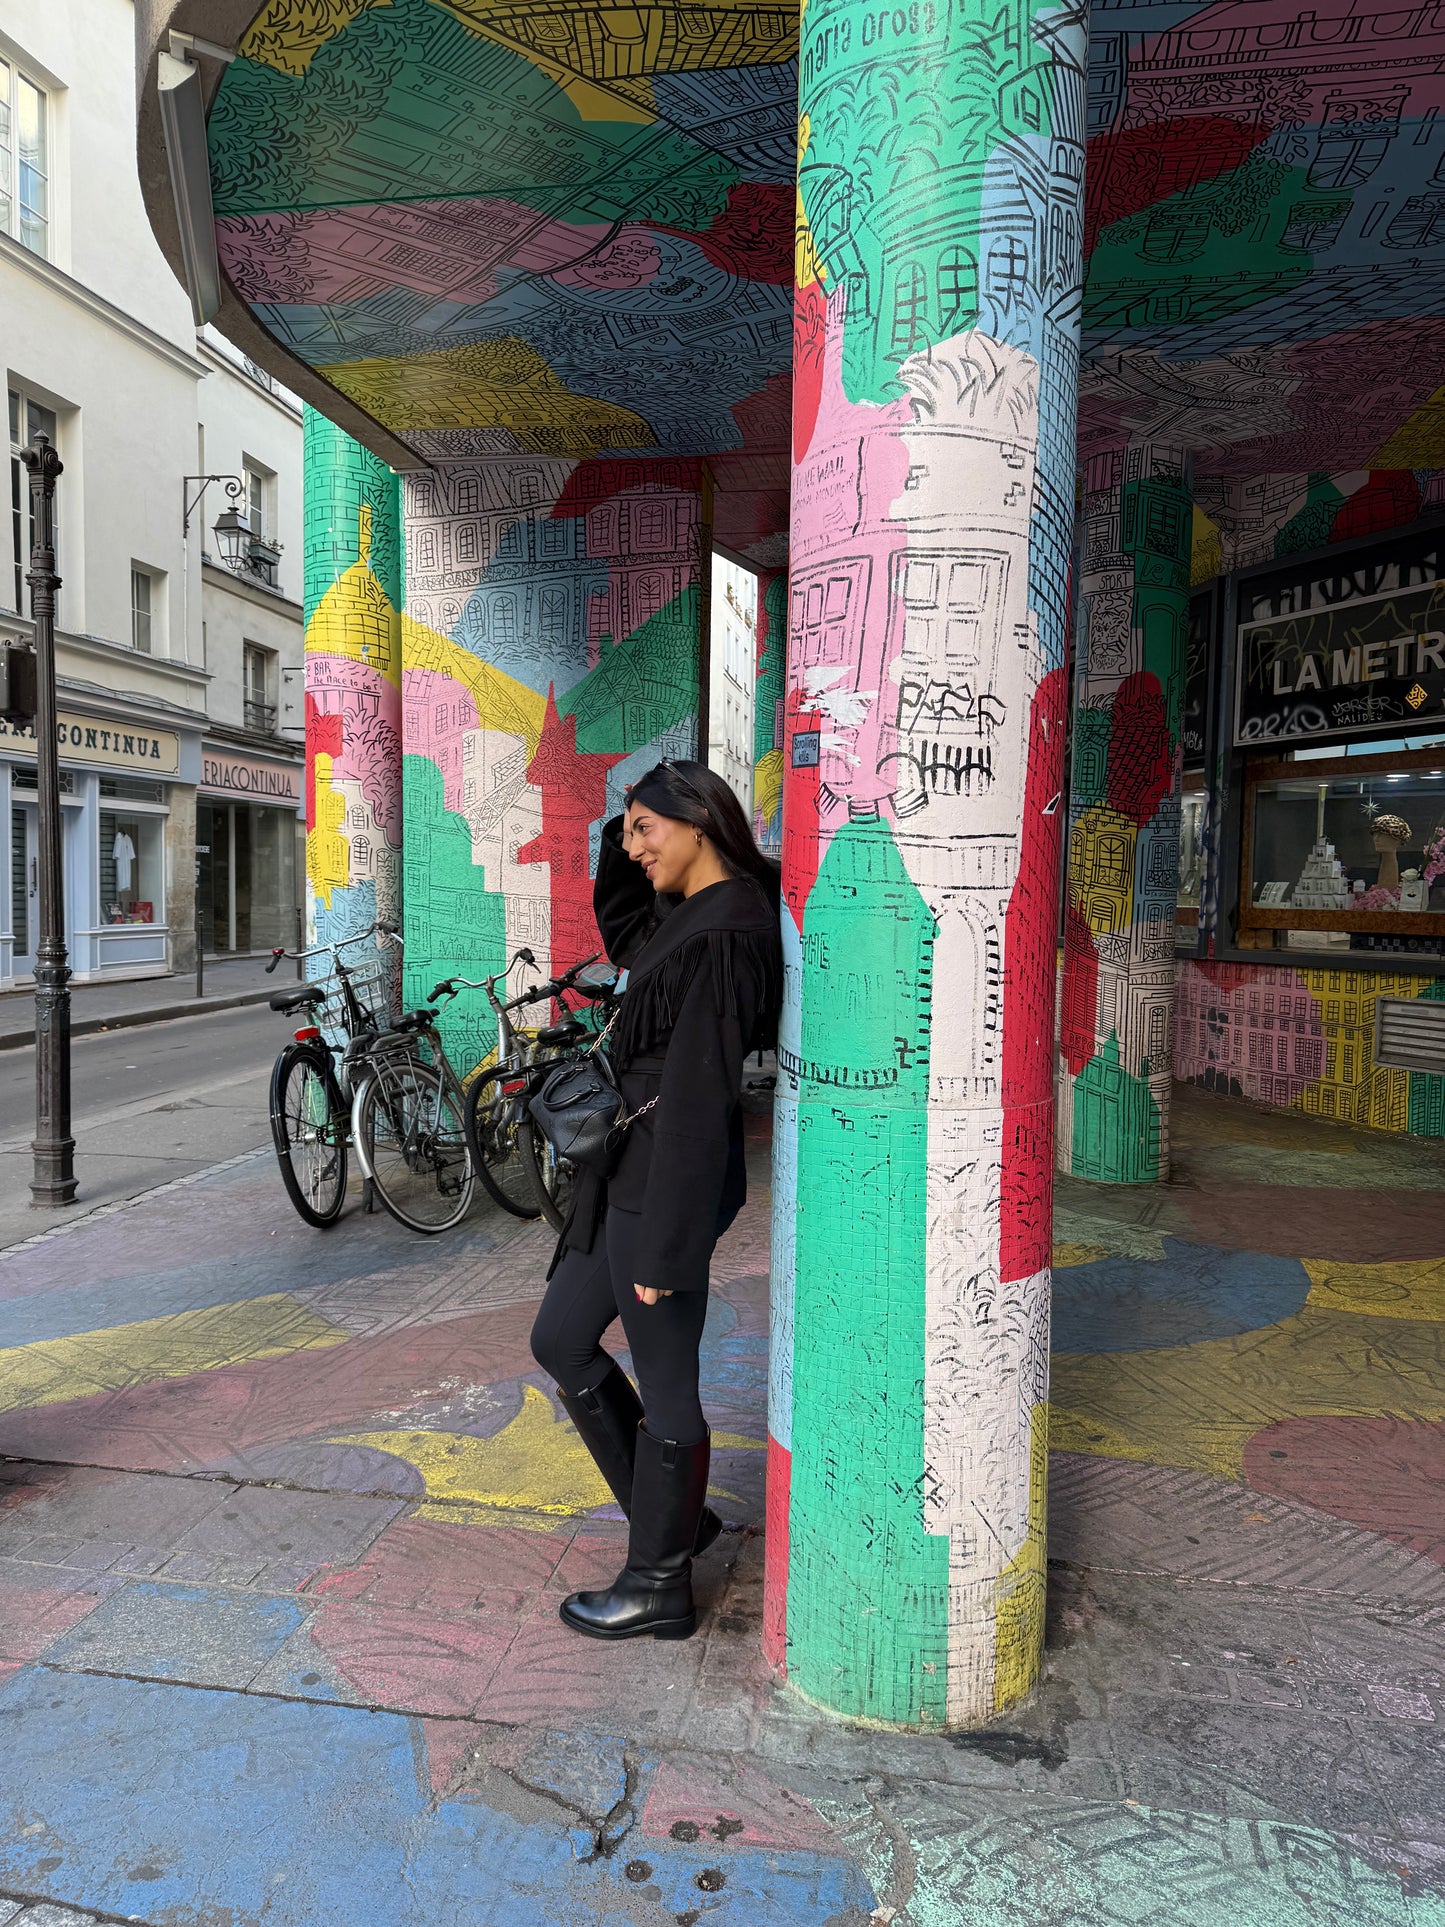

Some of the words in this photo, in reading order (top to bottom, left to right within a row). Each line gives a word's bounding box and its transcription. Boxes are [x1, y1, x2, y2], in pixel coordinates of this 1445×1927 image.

[1099, 571, 1131, 591] SPORT
[314, 661, 332, 677] BAR
[1273, 654, 1322, 696] LA
[57, 722, 161, 760] CONTINUA
[201, 759, 293, 797] ERIACONTINUA
